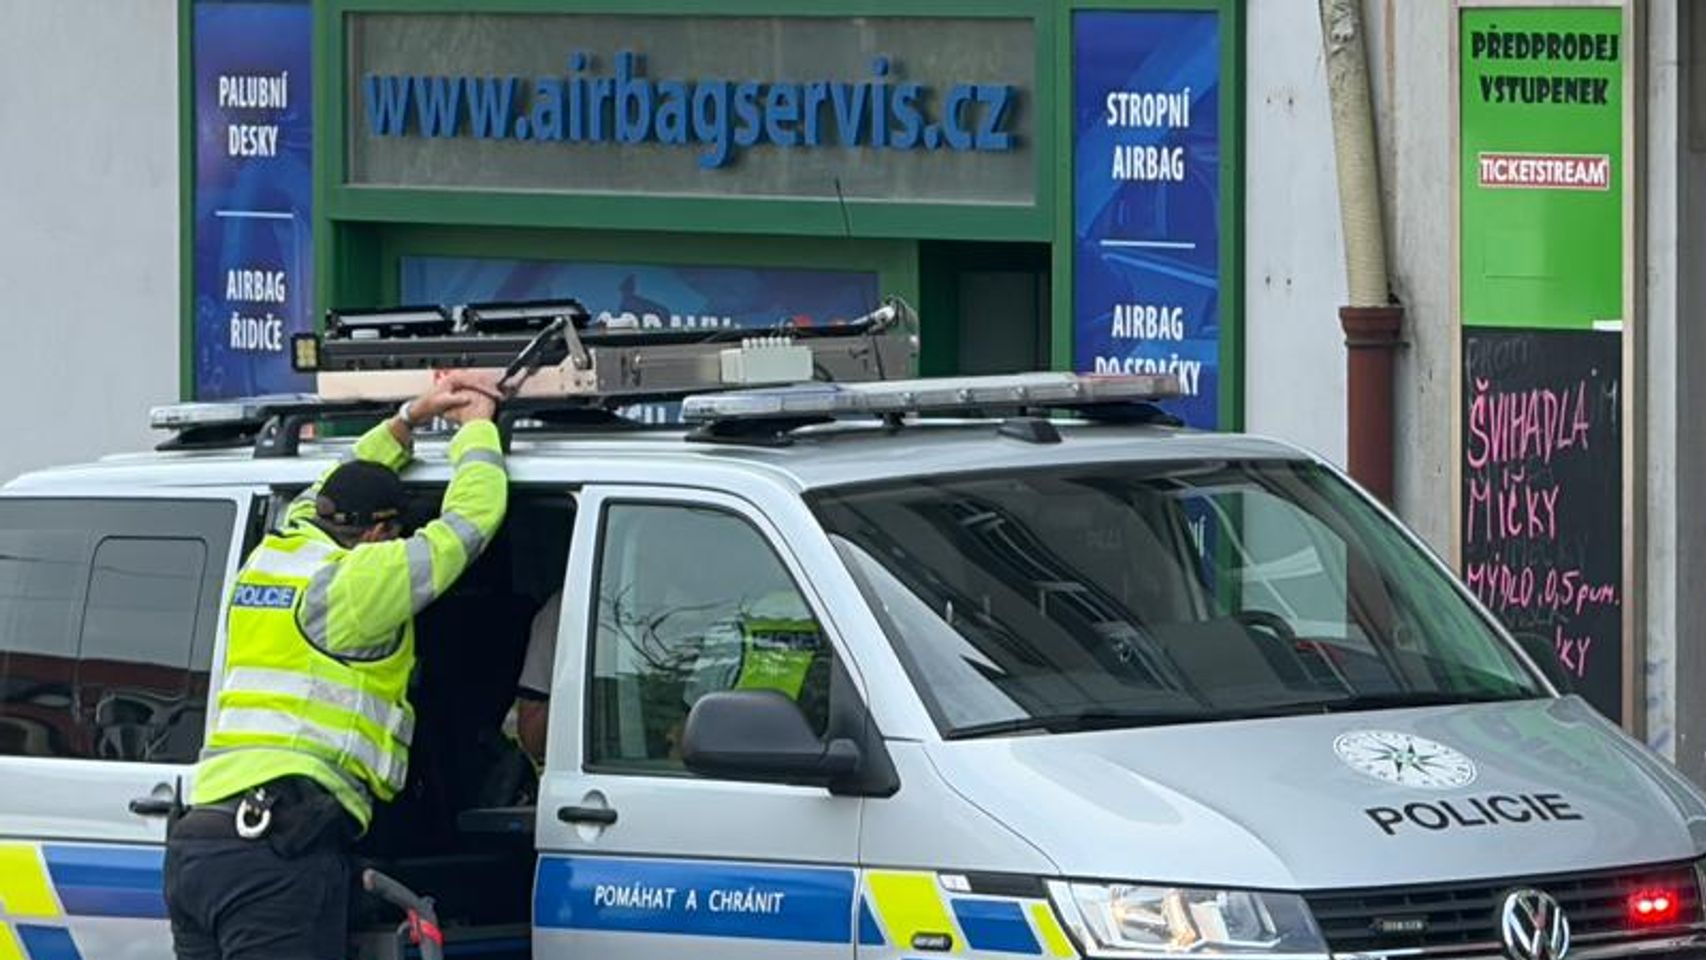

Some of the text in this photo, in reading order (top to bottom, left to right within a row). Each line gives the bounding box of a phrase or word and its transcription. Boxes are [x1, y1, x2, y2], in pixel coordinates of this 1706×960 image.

[1471, 24, 1619, 62] PŘEDPRODEJ
[218, 71, 288, 108] PALUBNÍ
[1106, 86, 1191, 130] STROPNÍ
[1480, 76, 1608, 104] VSTUPENEK
[363, 50, 1017, 168] www.airbagservis.cz
[228, 126, 279, 158] DESKY
[1111, 146, 1184, 182] AIRBAG
[1480, 158, 1606, 186] TICKETSTREAM
[226, 270, 286, 303] AIRBAG
[230, 313, 284, 352] ŘIDIČE
[1111, 304, 1184, 341] AIRBAG
[1467, 377, 1589, 468] ŠVIHADLA
[1467, 467, 1560, 542] MÍČKY
[235, 586, 294, 606] POLICIE
[1364, 794, 1585, 835] POLICIE
[594, 881, 785, 914] POMÁHAT A CHRÁNIT
